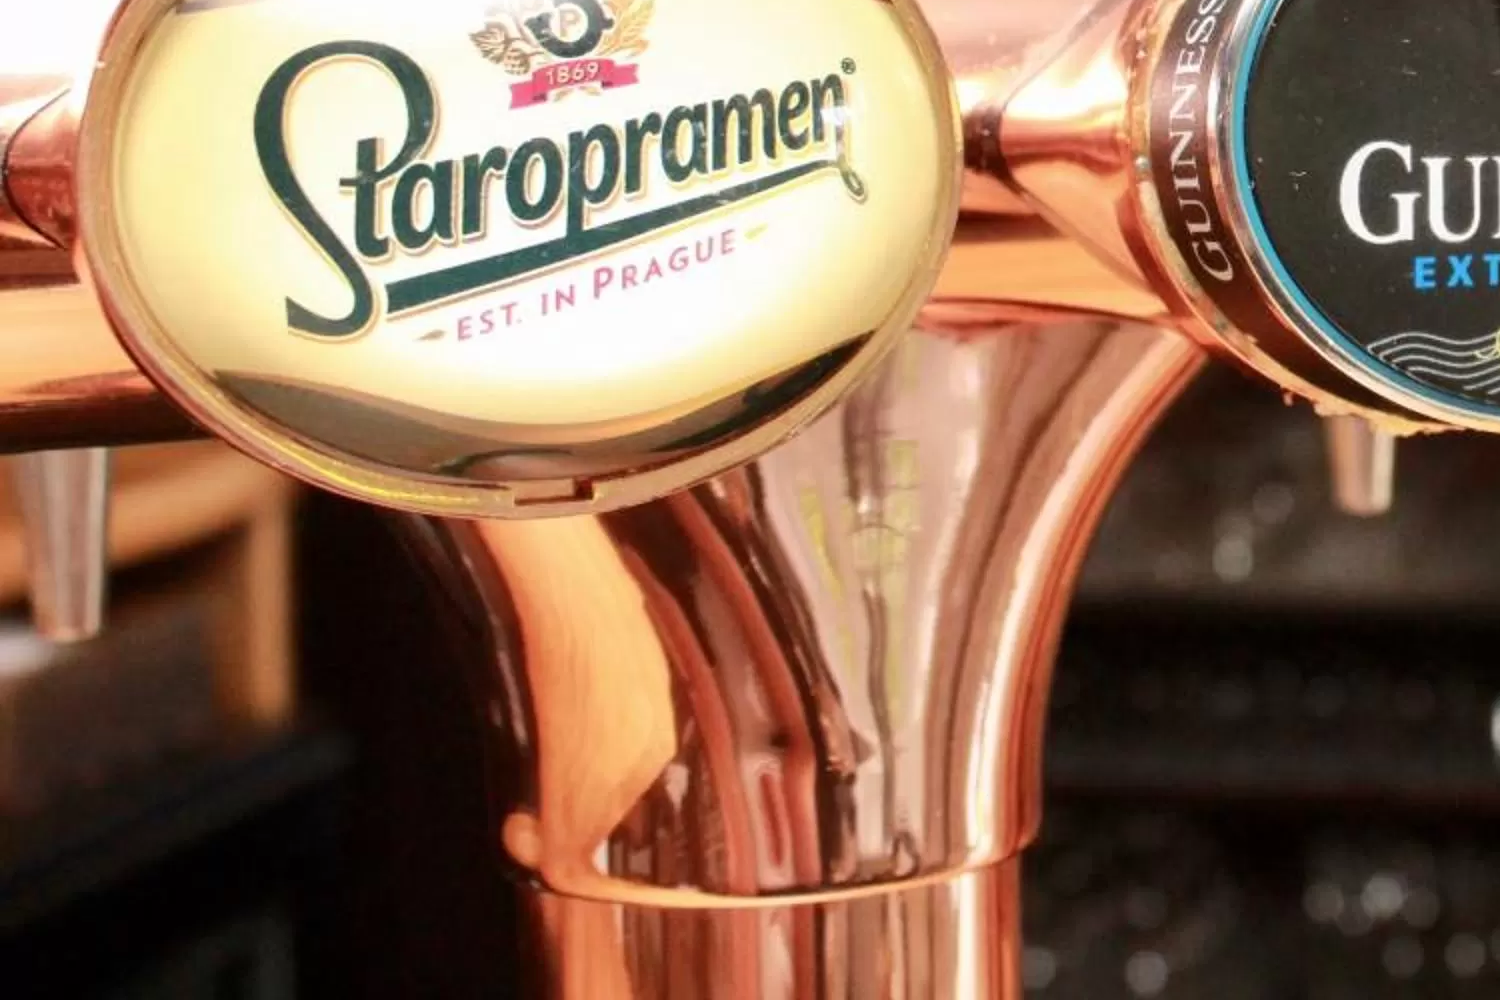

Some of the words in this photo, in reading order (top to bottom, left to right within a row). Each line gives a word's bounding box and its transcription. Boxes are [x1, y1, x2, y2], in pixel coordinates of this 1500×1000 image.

[545, 61, 600, 86] 1869
[253, 39, 866, 337] Staropramen
[456, 302, 522, 342] EST.
[540, 284, 577, 317] IN
[593, 229, 737, 299] PRAGUE
